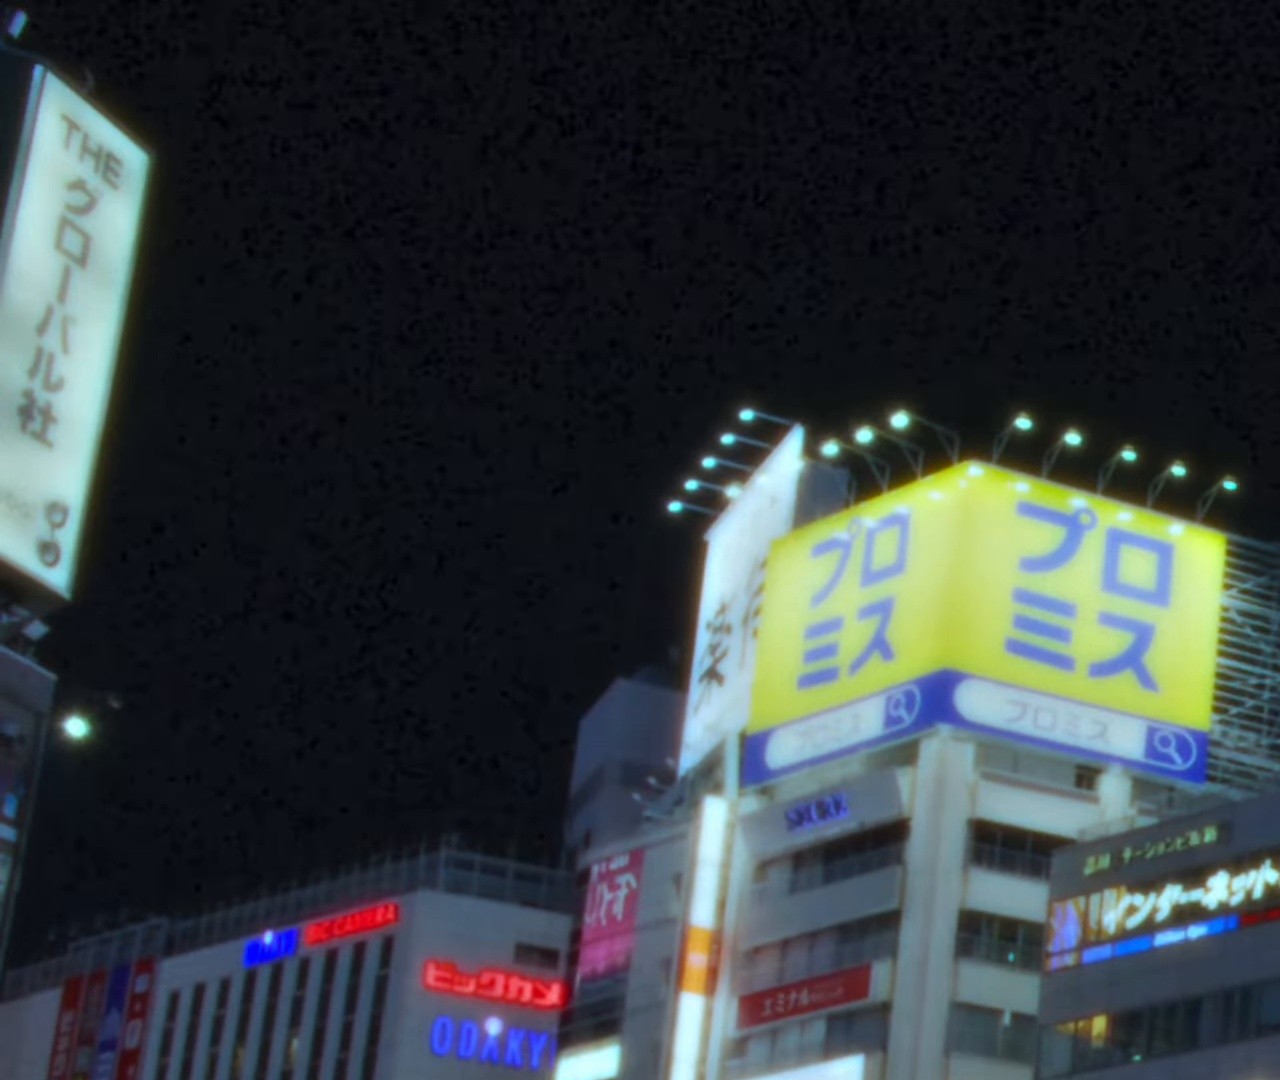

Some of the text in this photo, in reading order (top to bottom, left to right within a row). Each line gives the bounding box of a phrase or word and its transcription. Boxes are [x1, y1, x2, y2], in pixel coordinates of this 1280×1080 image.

[60, 113, 124, 191] THE
[810, 512, 912, 609] プロ
[1014, 501, 1176, 608] プロ
[797, 596, 894, 691] ミス
[1004, 587, 1159, 693] ミス
[423, 957, 566, 1010] ビックカメ
[430, 1015, 556, 1073] ODAKY
